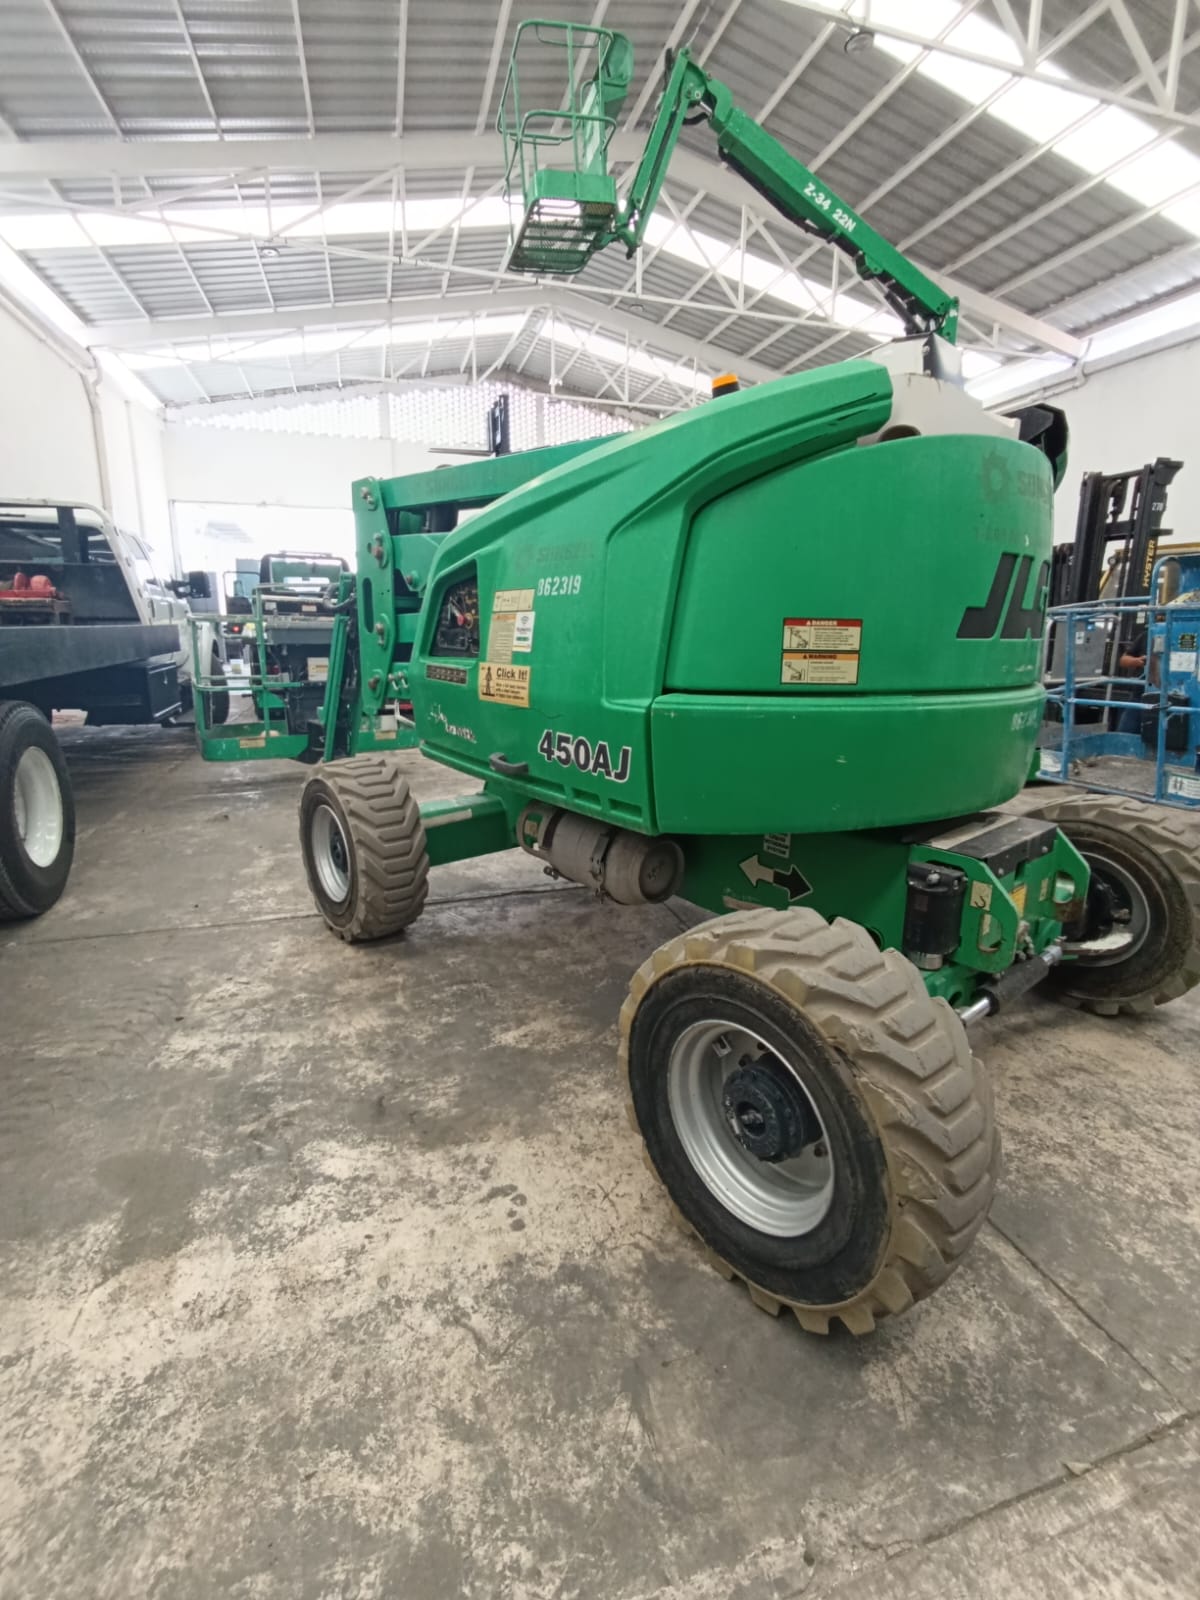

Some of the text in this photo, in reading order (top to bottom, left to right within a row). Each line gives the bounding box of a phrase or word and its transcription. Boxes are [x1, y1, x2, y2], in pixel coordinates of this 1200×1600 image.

[803, 182, 857, 233] Z-34 22N
[537, 574, 582, 597] 862319
[1142, 539, 1156, 588] HYSTER
[496, 666, 529, 681] Click It!
[537, 728, 632, 784] 450AJ
